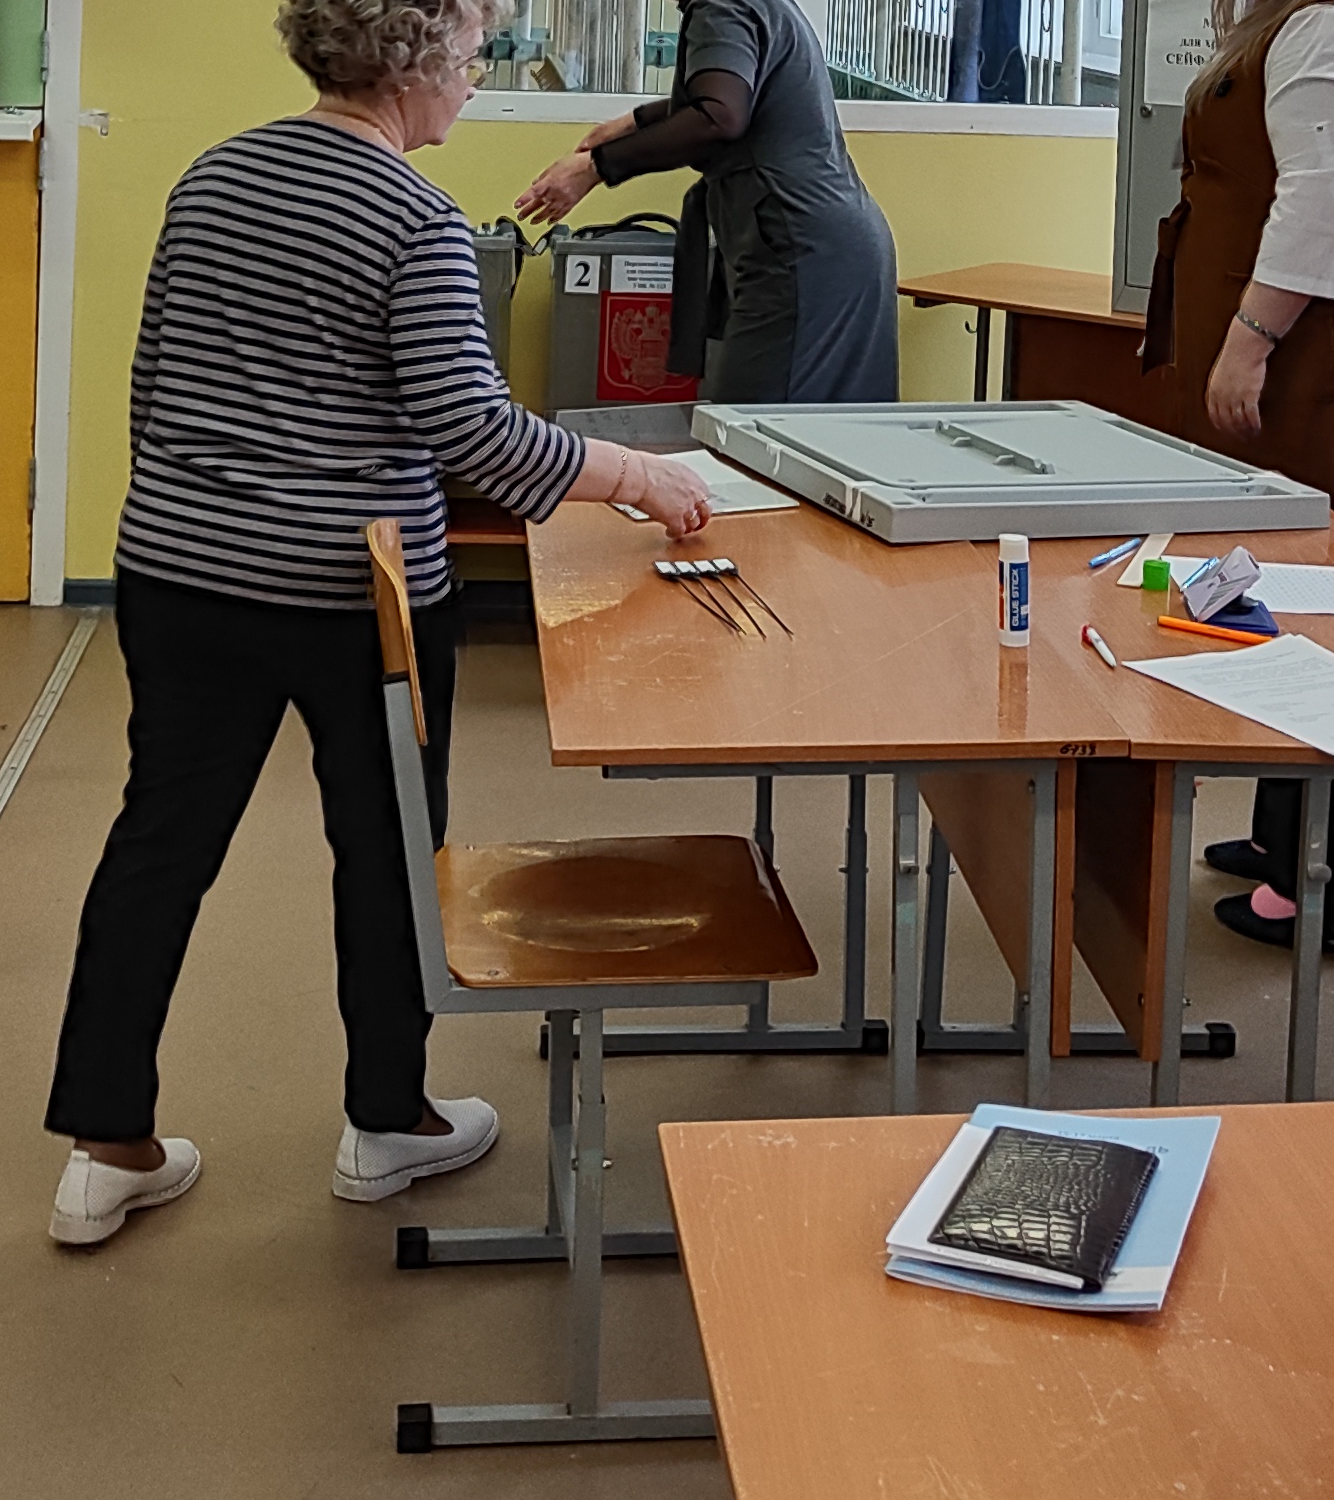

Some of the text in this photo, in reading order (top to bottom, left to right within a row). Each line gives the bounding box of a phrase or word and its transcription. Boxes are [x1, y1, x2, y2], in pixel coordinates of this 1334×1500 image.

[573, 260, 591, 288] 2
[1011, 568, 1020, 627] GLUE STICK
